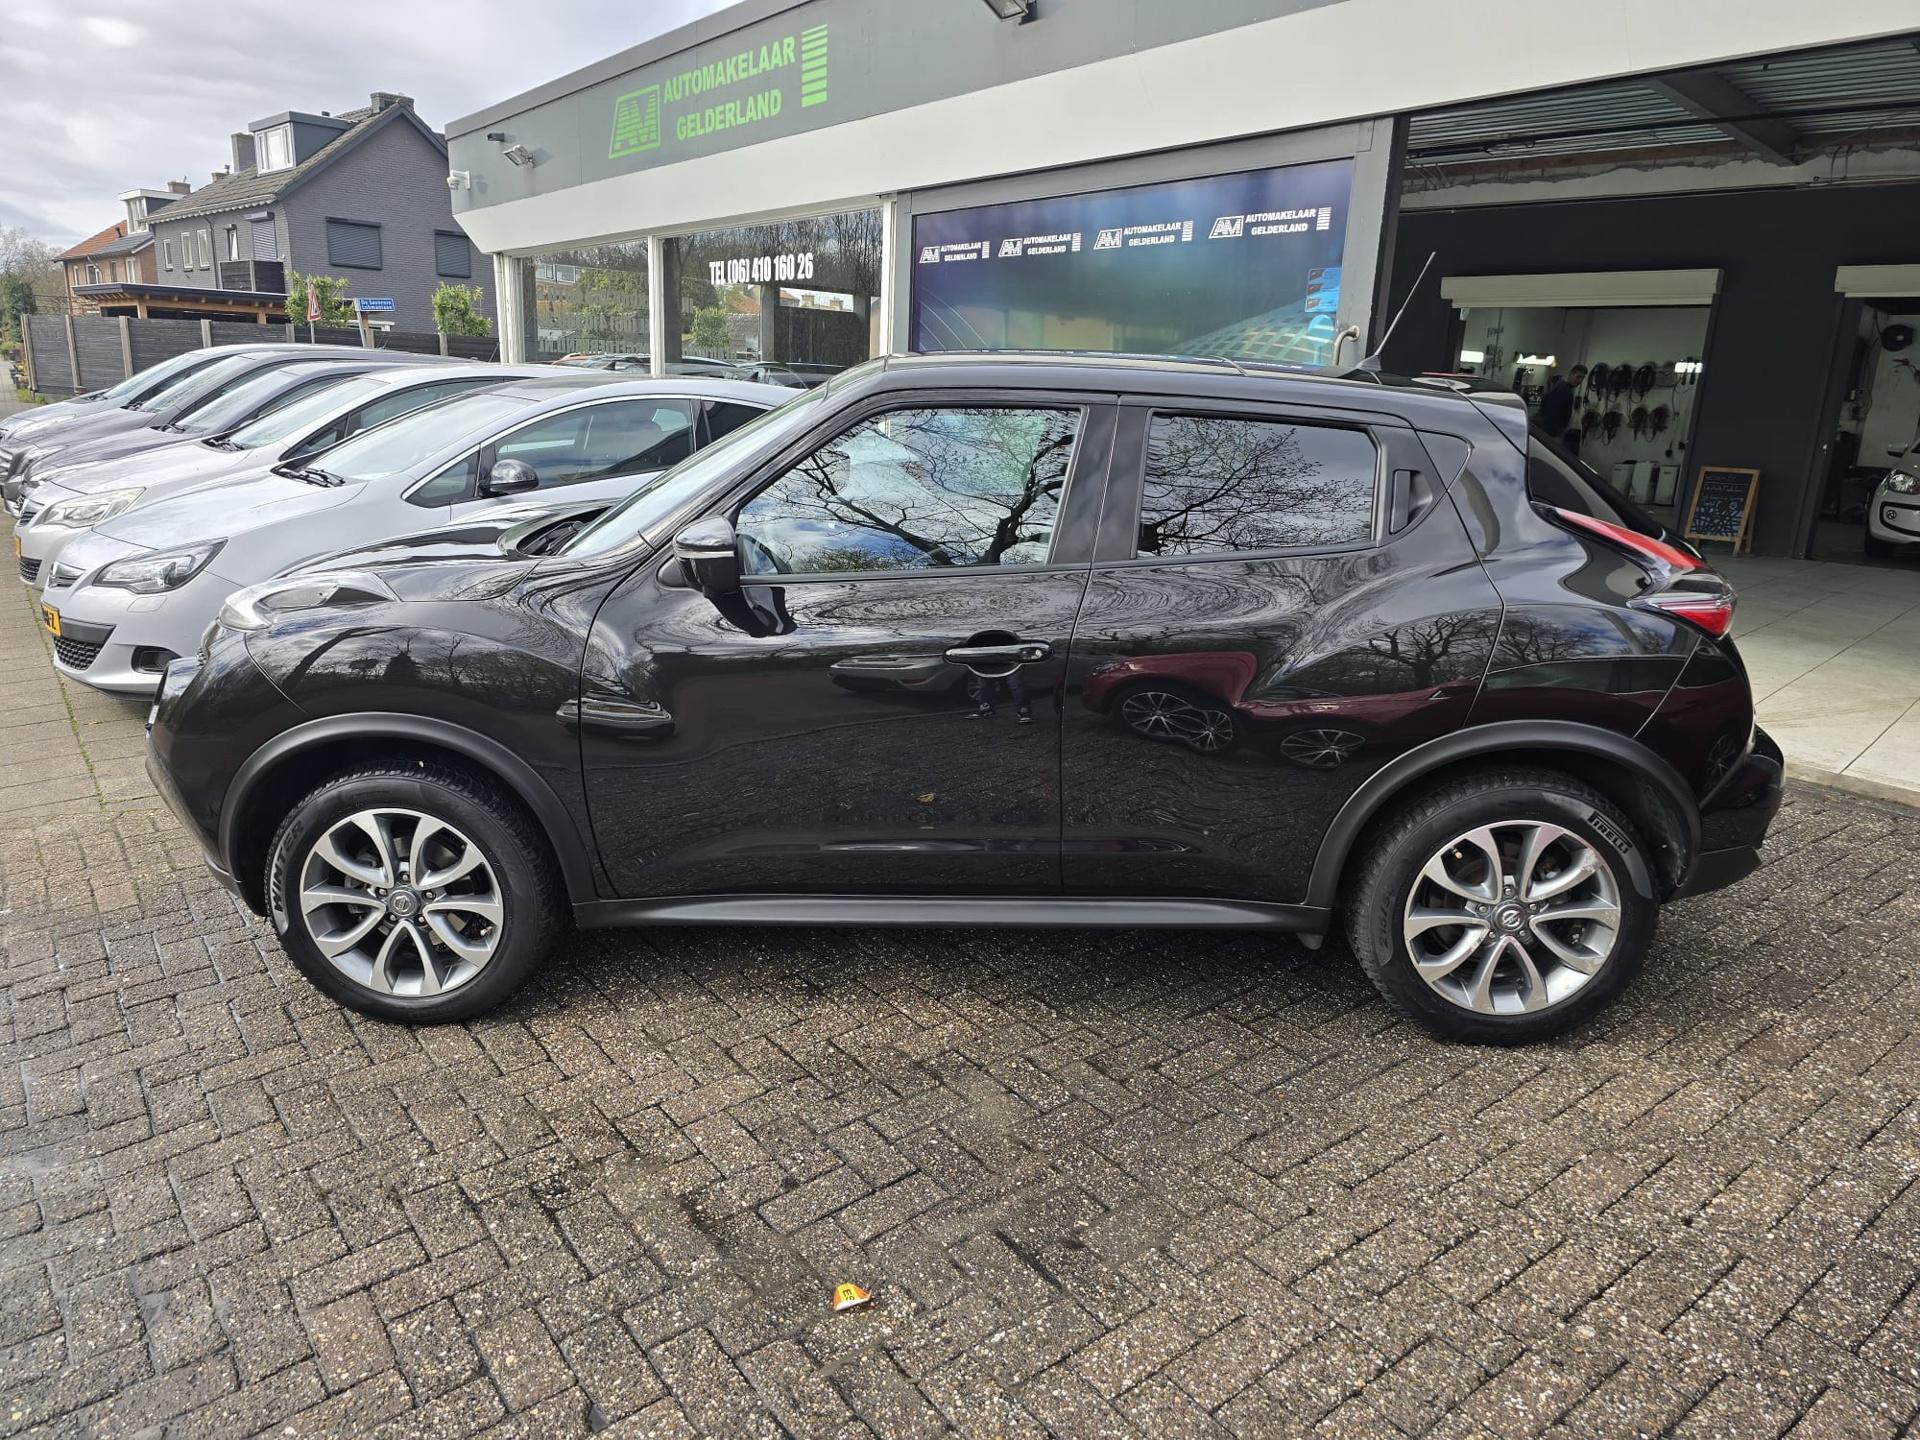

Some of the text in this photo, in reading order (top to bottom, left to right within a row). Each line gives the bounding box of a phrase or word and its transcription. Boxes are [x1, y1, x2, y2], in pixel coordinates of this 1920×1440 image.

[663, 36, 796, 104] AUTOMAKELAAR
[676, 88, 783, 141] GELDERLAND
[1245, 208, 1317, 223] AUTOMAKELAAR
[1123, 221, 1182, 236] AUTOMAKELAAR
[1251, 222, 1309, 236] GELDERLAND
[1023, 233, 1072, 245] AUTOMAKELAAR
[1128, 235, 1175, 247] GELDERLAND
[1027, 244, 1066, 255] GELDERLAND
[709, 252, 814, 285] TEL (06) 410 160 26
[1587, 810, 1632, 854] PIRELLI
[271, 820, 305, 913] WINTER
